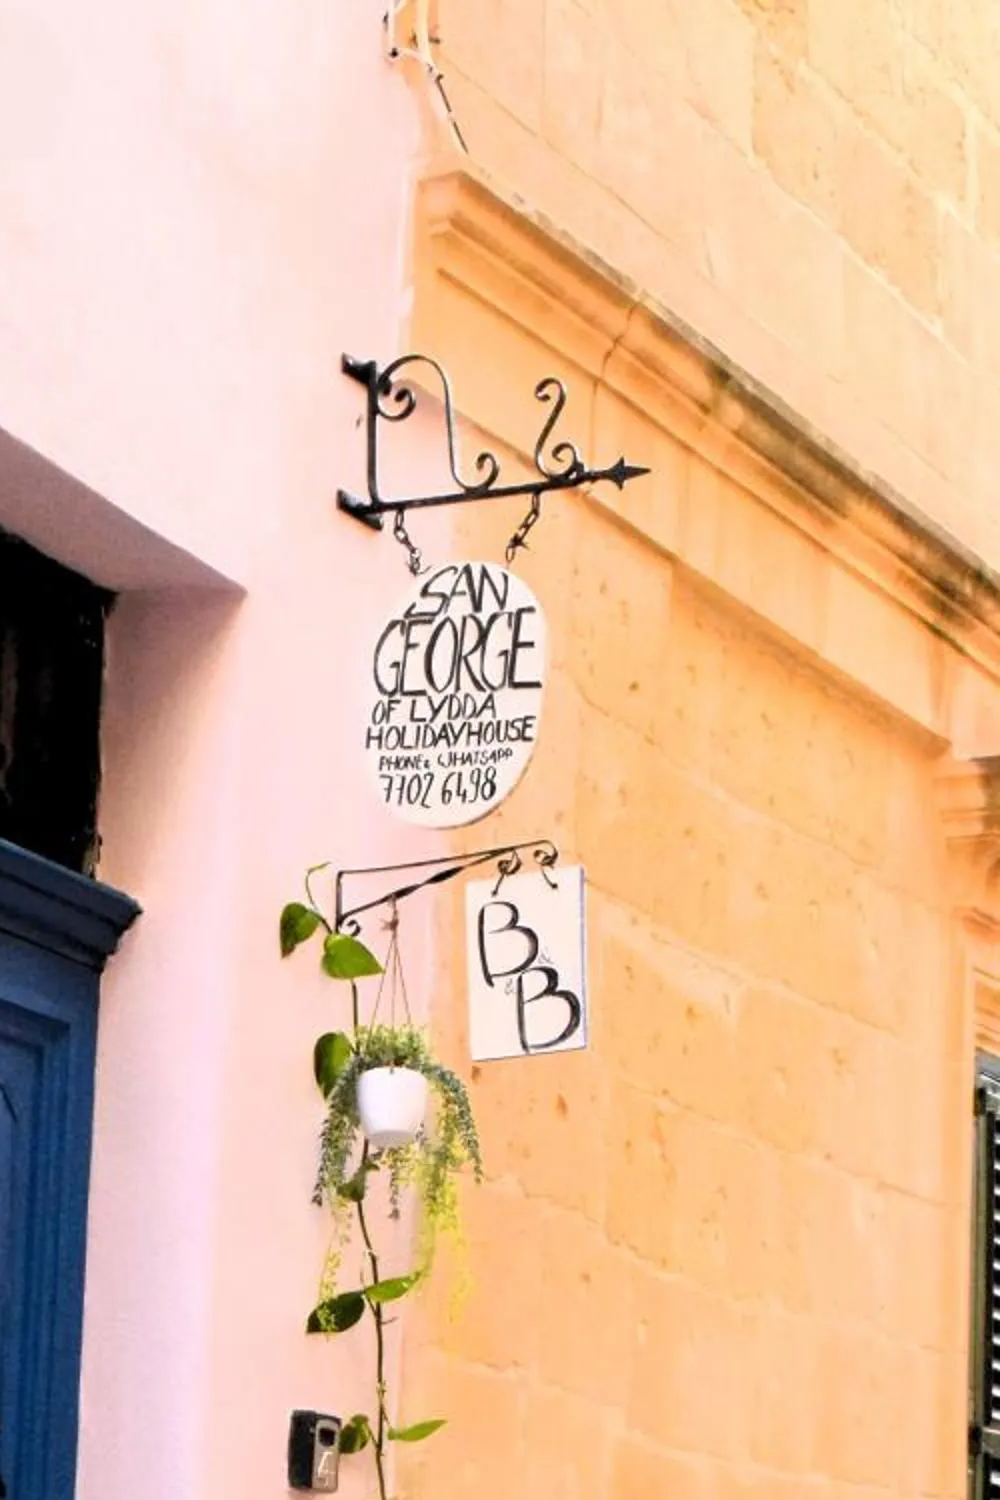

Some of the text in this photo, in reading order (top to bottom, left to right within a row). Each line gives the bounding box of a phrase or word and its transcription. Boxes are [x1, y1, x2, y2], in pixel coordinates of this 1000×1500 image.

[404, 563, 509, 619] SAN
[373, 606, 543, 697] GEORGE
[372, 693, 496, 725] OF LYDDA
[437, 747, 514, 768] WHATSAPP
[379, 766, 498, 809] 7702 6498
